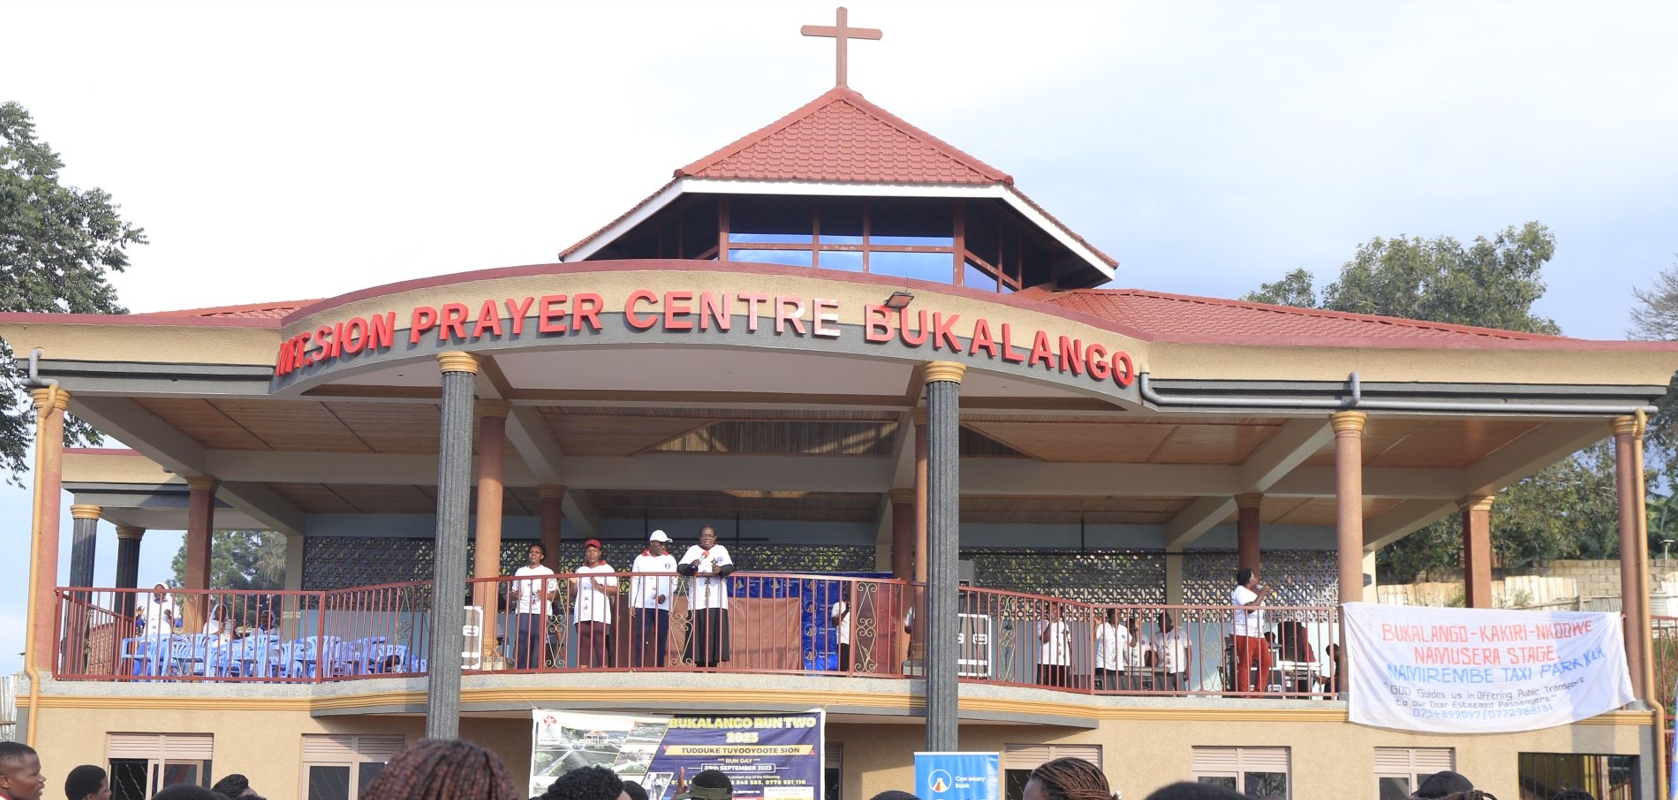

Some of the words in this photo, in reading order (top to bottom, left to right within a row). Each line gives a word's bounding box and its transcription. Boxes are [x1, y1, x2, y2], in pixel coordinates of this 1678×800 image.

[409, 291, 604, 344] PRAYER
[625, 289, 842, 337] CENTRE
[864, 302, 1136, 387] BUKALANGO
[1414, 646, 1501, 666] NAMUSERA
[1507, 645, 1561, 665] STAGE.
[1387, 664, 1494, 684] NAMIREMBE
[1501, 667, 1533, 682] TAXI
[1540, 658, 1584, 679] PARK
[1417, 689, 1446, 699] Guides
[1451, 691, 1463, 699] us
[1477, 690, 1513, 701] Offering
[1517, 688, 1540, 698] Public
[1544, 676, 1585, 693] Transport
[1396, 698, 1408, 707] to
[1429, 700, 1449, 709] Dear
[1452, 700, 1494, 709] Esteemed
[668, 717, 753, 729] BUKALANGO
[753, 717, 783, 729] RUN
[783, 716, 817, 729] TWO
[725, 731, 760, 744] 2023
